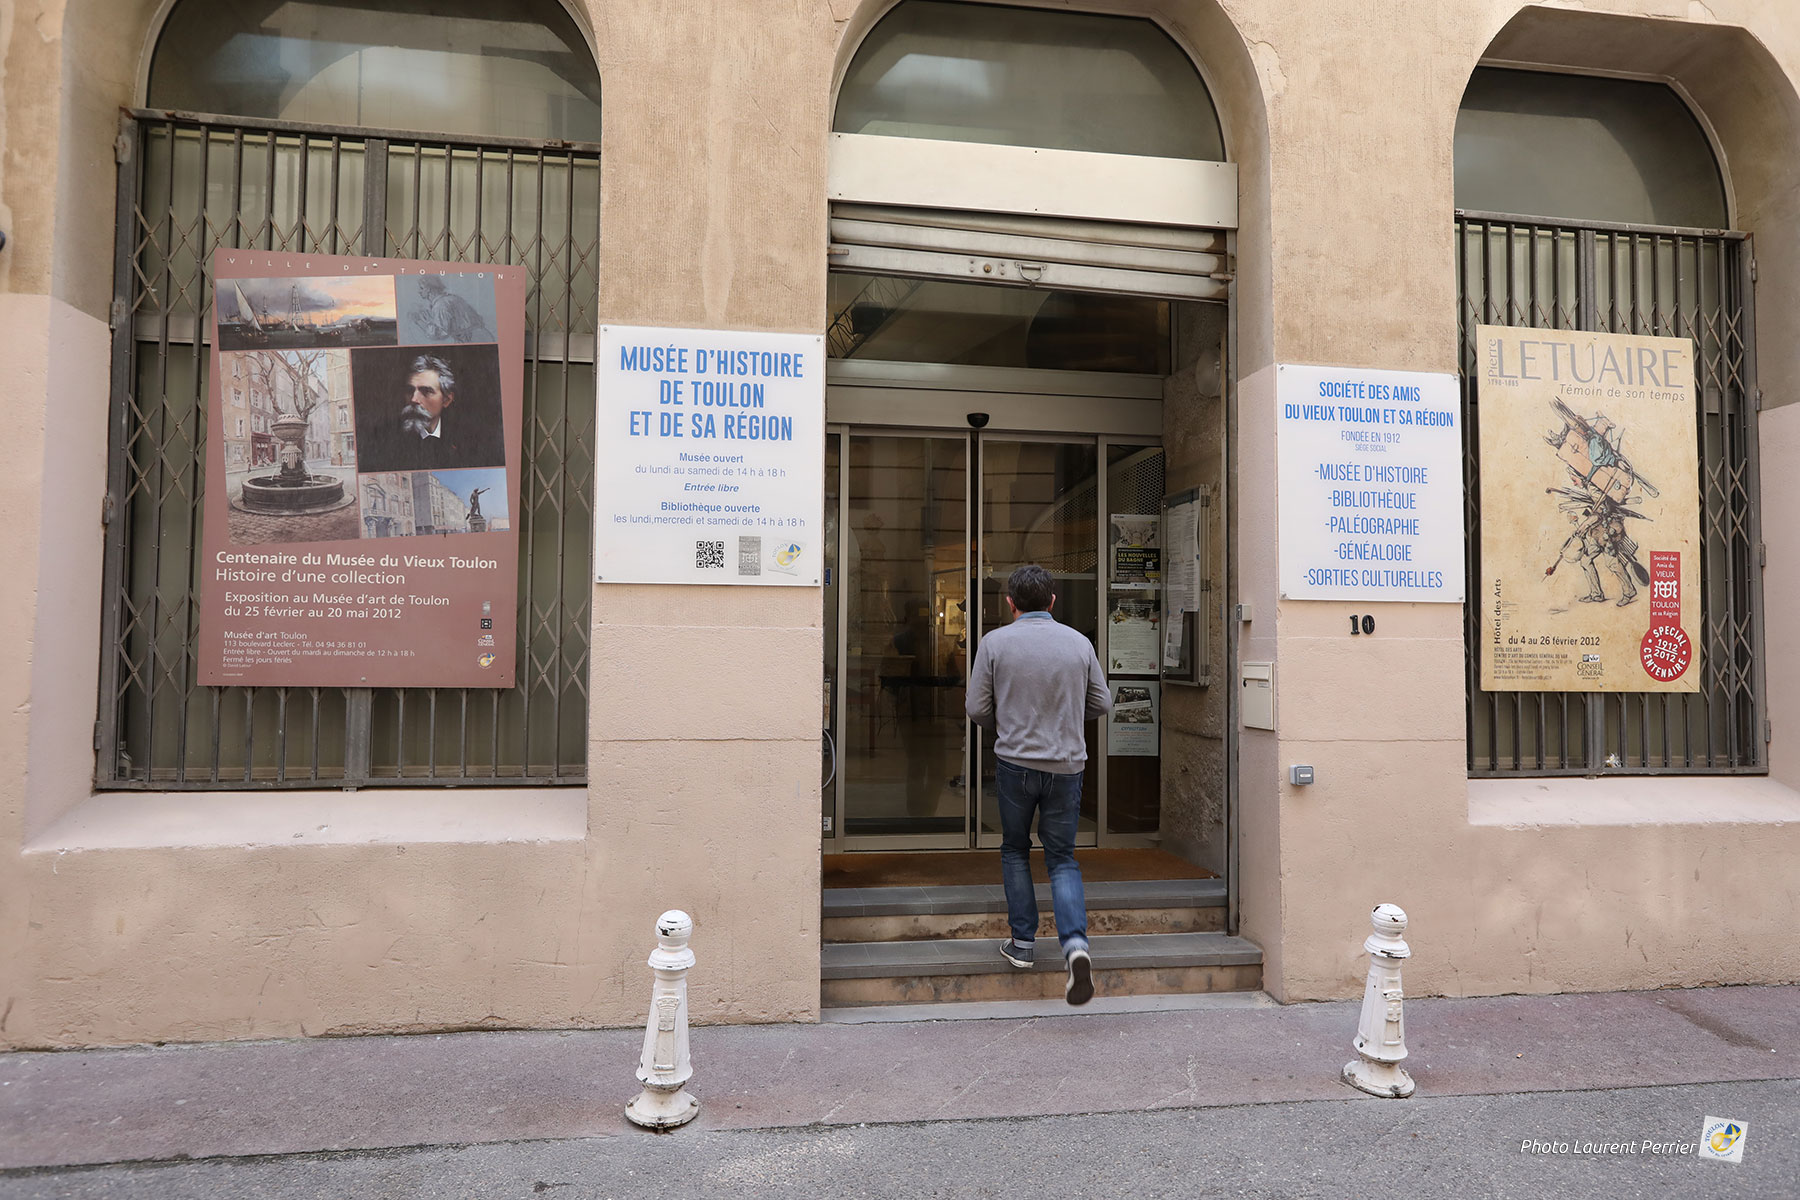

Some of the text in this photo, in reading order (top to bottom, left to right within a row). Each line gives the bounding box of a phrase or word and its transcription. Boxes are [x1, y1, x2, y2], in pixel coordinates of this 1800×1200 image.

[229, 258, 504, 280] VILLE DE TOULON
[620, 344, 803, 378] MUSÉE D’HISTOIRE
[1488, 338, 1498, 377] Pierre
[1497, 338, 1684, 388] LETUAIRE
[660, 380, 764, 408] DE TOULON
[1319, 380, 1421, 402] SOCIÉTÉ DES AMIS
[1559, 384, 1685, 403] Témoin de son temps
[1285, 404, 1454, 427] DU VIEUX TOULON ET SA RÉGION
[630, 410, 792, 441] ET DE SA RÉGION
[1341, 430, 1401, 444] FONDÉE EN 1912
[1370, 444, 1387, 452] SOCIAL
[679, 452, 744, 464] Musée ouvert
[635, 465, 786, 477] du lundi au samedi de 14 h à 18 h
[1314, 462, 1428, 484] -MUSÉE D'HISTOIRE
[684, 483, 740, 493] Entrée libre
[660, 502, 761, 514] Bibliothèque ouverte
[1327, 489, 1417, 510] -BIBLIOTHÈQUE
[613, 514, 627, 524] les
[696, 517, 705, 525] et
[707, 516, 740, 526] samedi
[742, 517, 754, 526] de
[756, 518, 767, 527] 14
[769, 518, 776, 527] h
[778, 518, 783, 527] à
[786, 518, 797, 527] 18
[800, 518, 806, 527] h
[1325, 514, 1420, 536] -PALÉOGRAPHIE
[1334, 540, 1412, 561] -GÉNÉALOGIE
[216, 551, 497, 569] Centenaire du Musée du Vieux Toulon
[216, 568, 405, 584] Histoire d’une collection
[1303, 568, 1443, 588] -SORTIES CULTURELLES
[1656, 570, 1675, 578] VIEUX
[225, 592, 450, 606] Exposition au Musée d’art de Toulon
[224, 606, 401, 619] du 25 février au 20 mai 2012
[1350, 615, 1376, 635] 10
[224, 631, 308, 640] Musée d'art Toulon
[273, 640, 295, 648] Leclerc
[1508, 636, 1600, 646] du 4 au 26 février 2012
[1653, 625, 1687, 647] SPECIAL
[1657, 639, 1679, 652] 1912
[1644, 647, 1687, 678] CENTENAIRE
[1653, 649, 1676, 663] 2012
